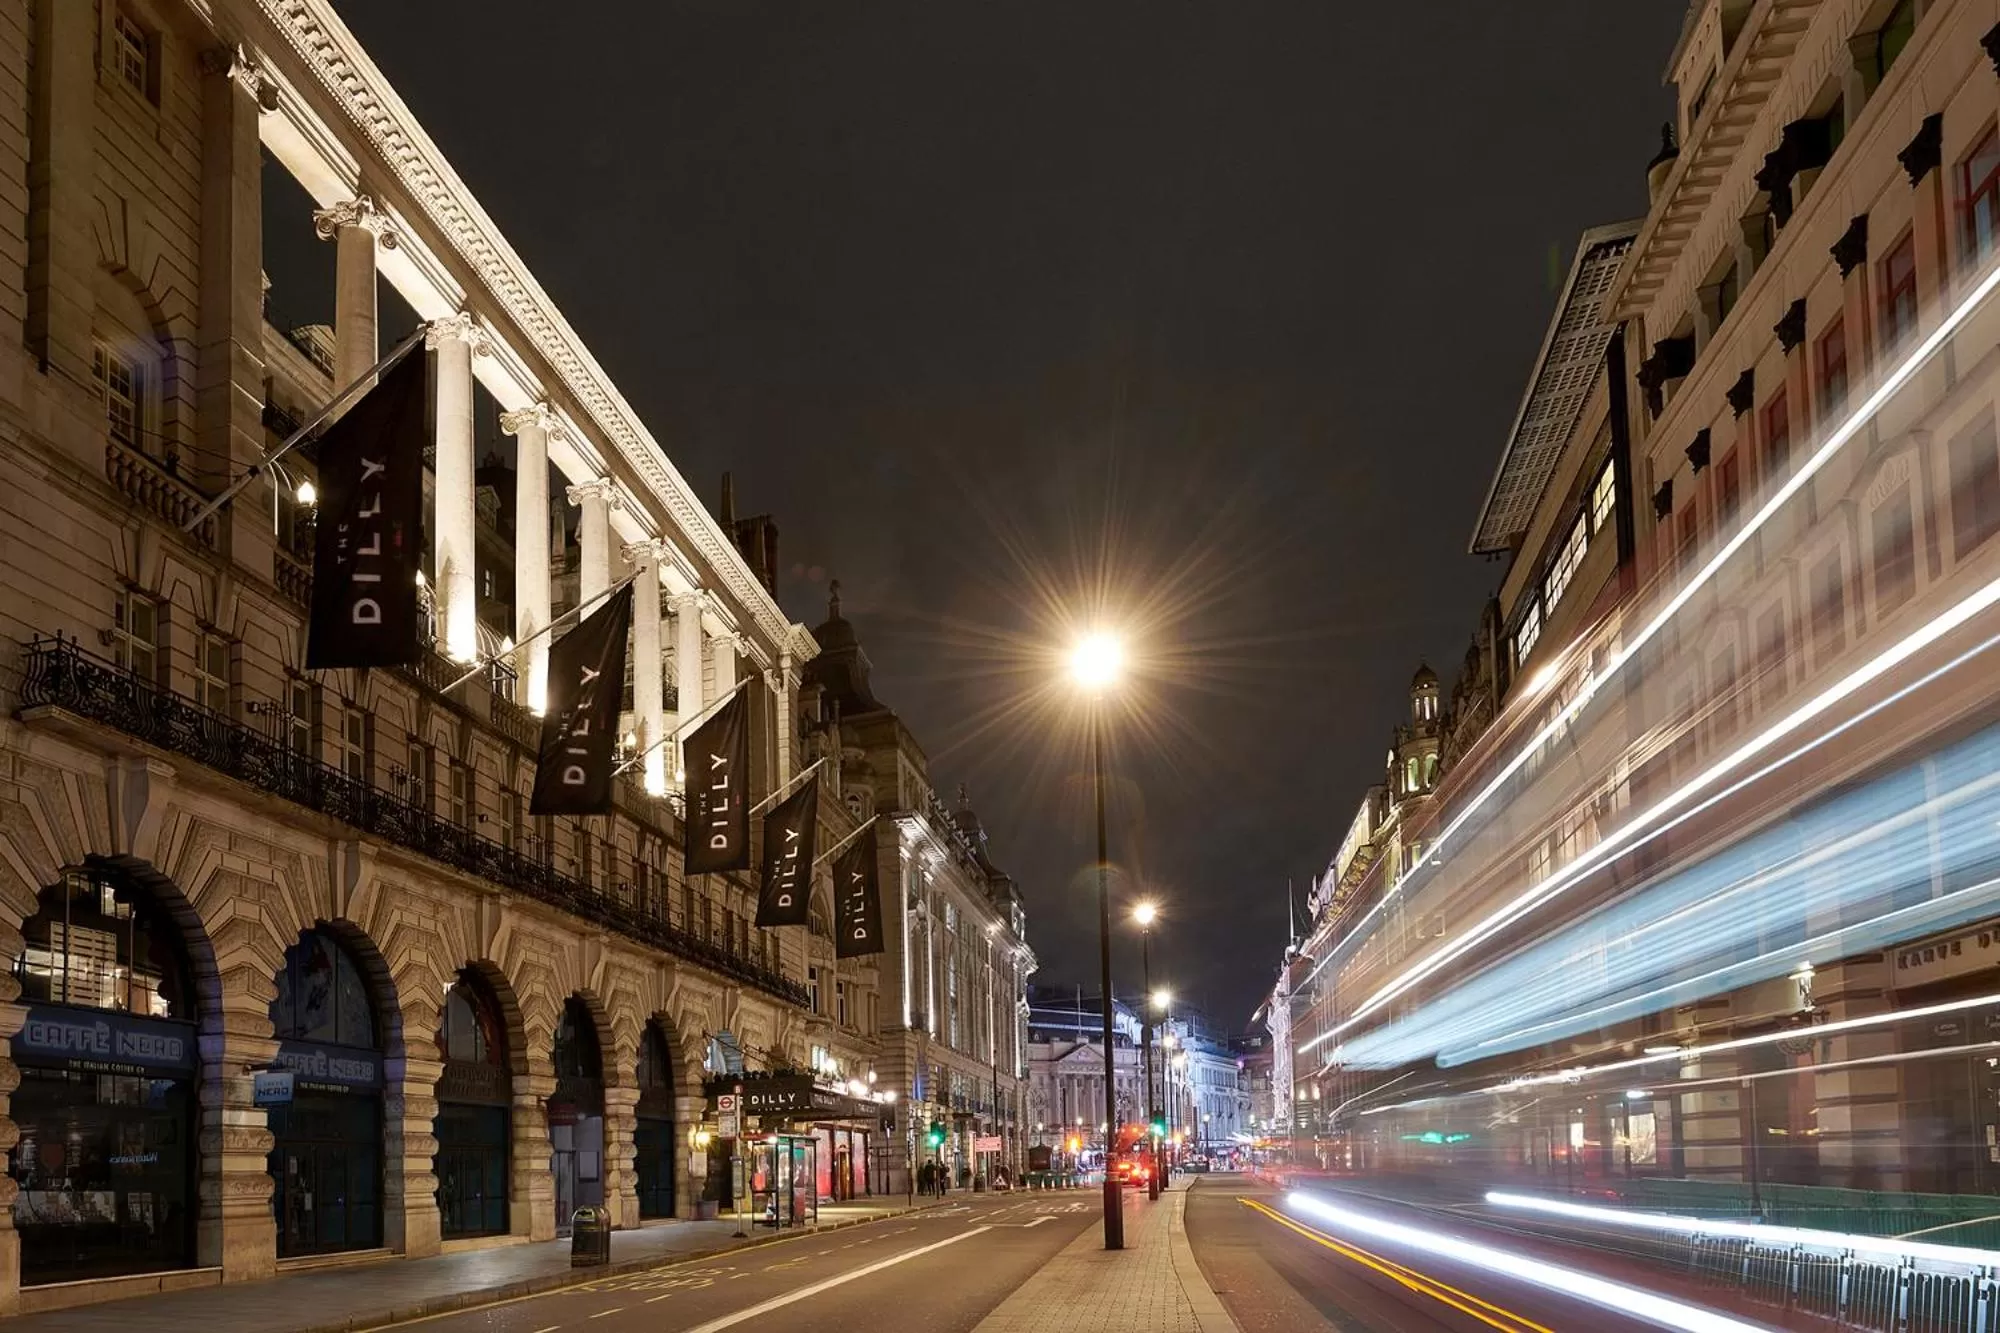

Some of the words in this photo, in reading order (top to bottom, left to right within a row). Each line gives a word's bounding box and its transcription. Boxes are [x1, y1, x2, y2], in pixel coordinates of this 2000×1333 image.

[336, 522, 349, 565] THE
[352, 457, 386, 625] DILLY
[562, 664, 601, 785] DILLY
[699, 792, 707, 817] THE
[710, 753, 729, 849] DILLY
[777, 828, 800, 908] DILLY
[852, 871, 867, 940] DILLY
[116, 1029, 184, 1061] NERO
[257, 1087, 289, 1097] NERO
[751, 1092, 796, 1105] DILLY
